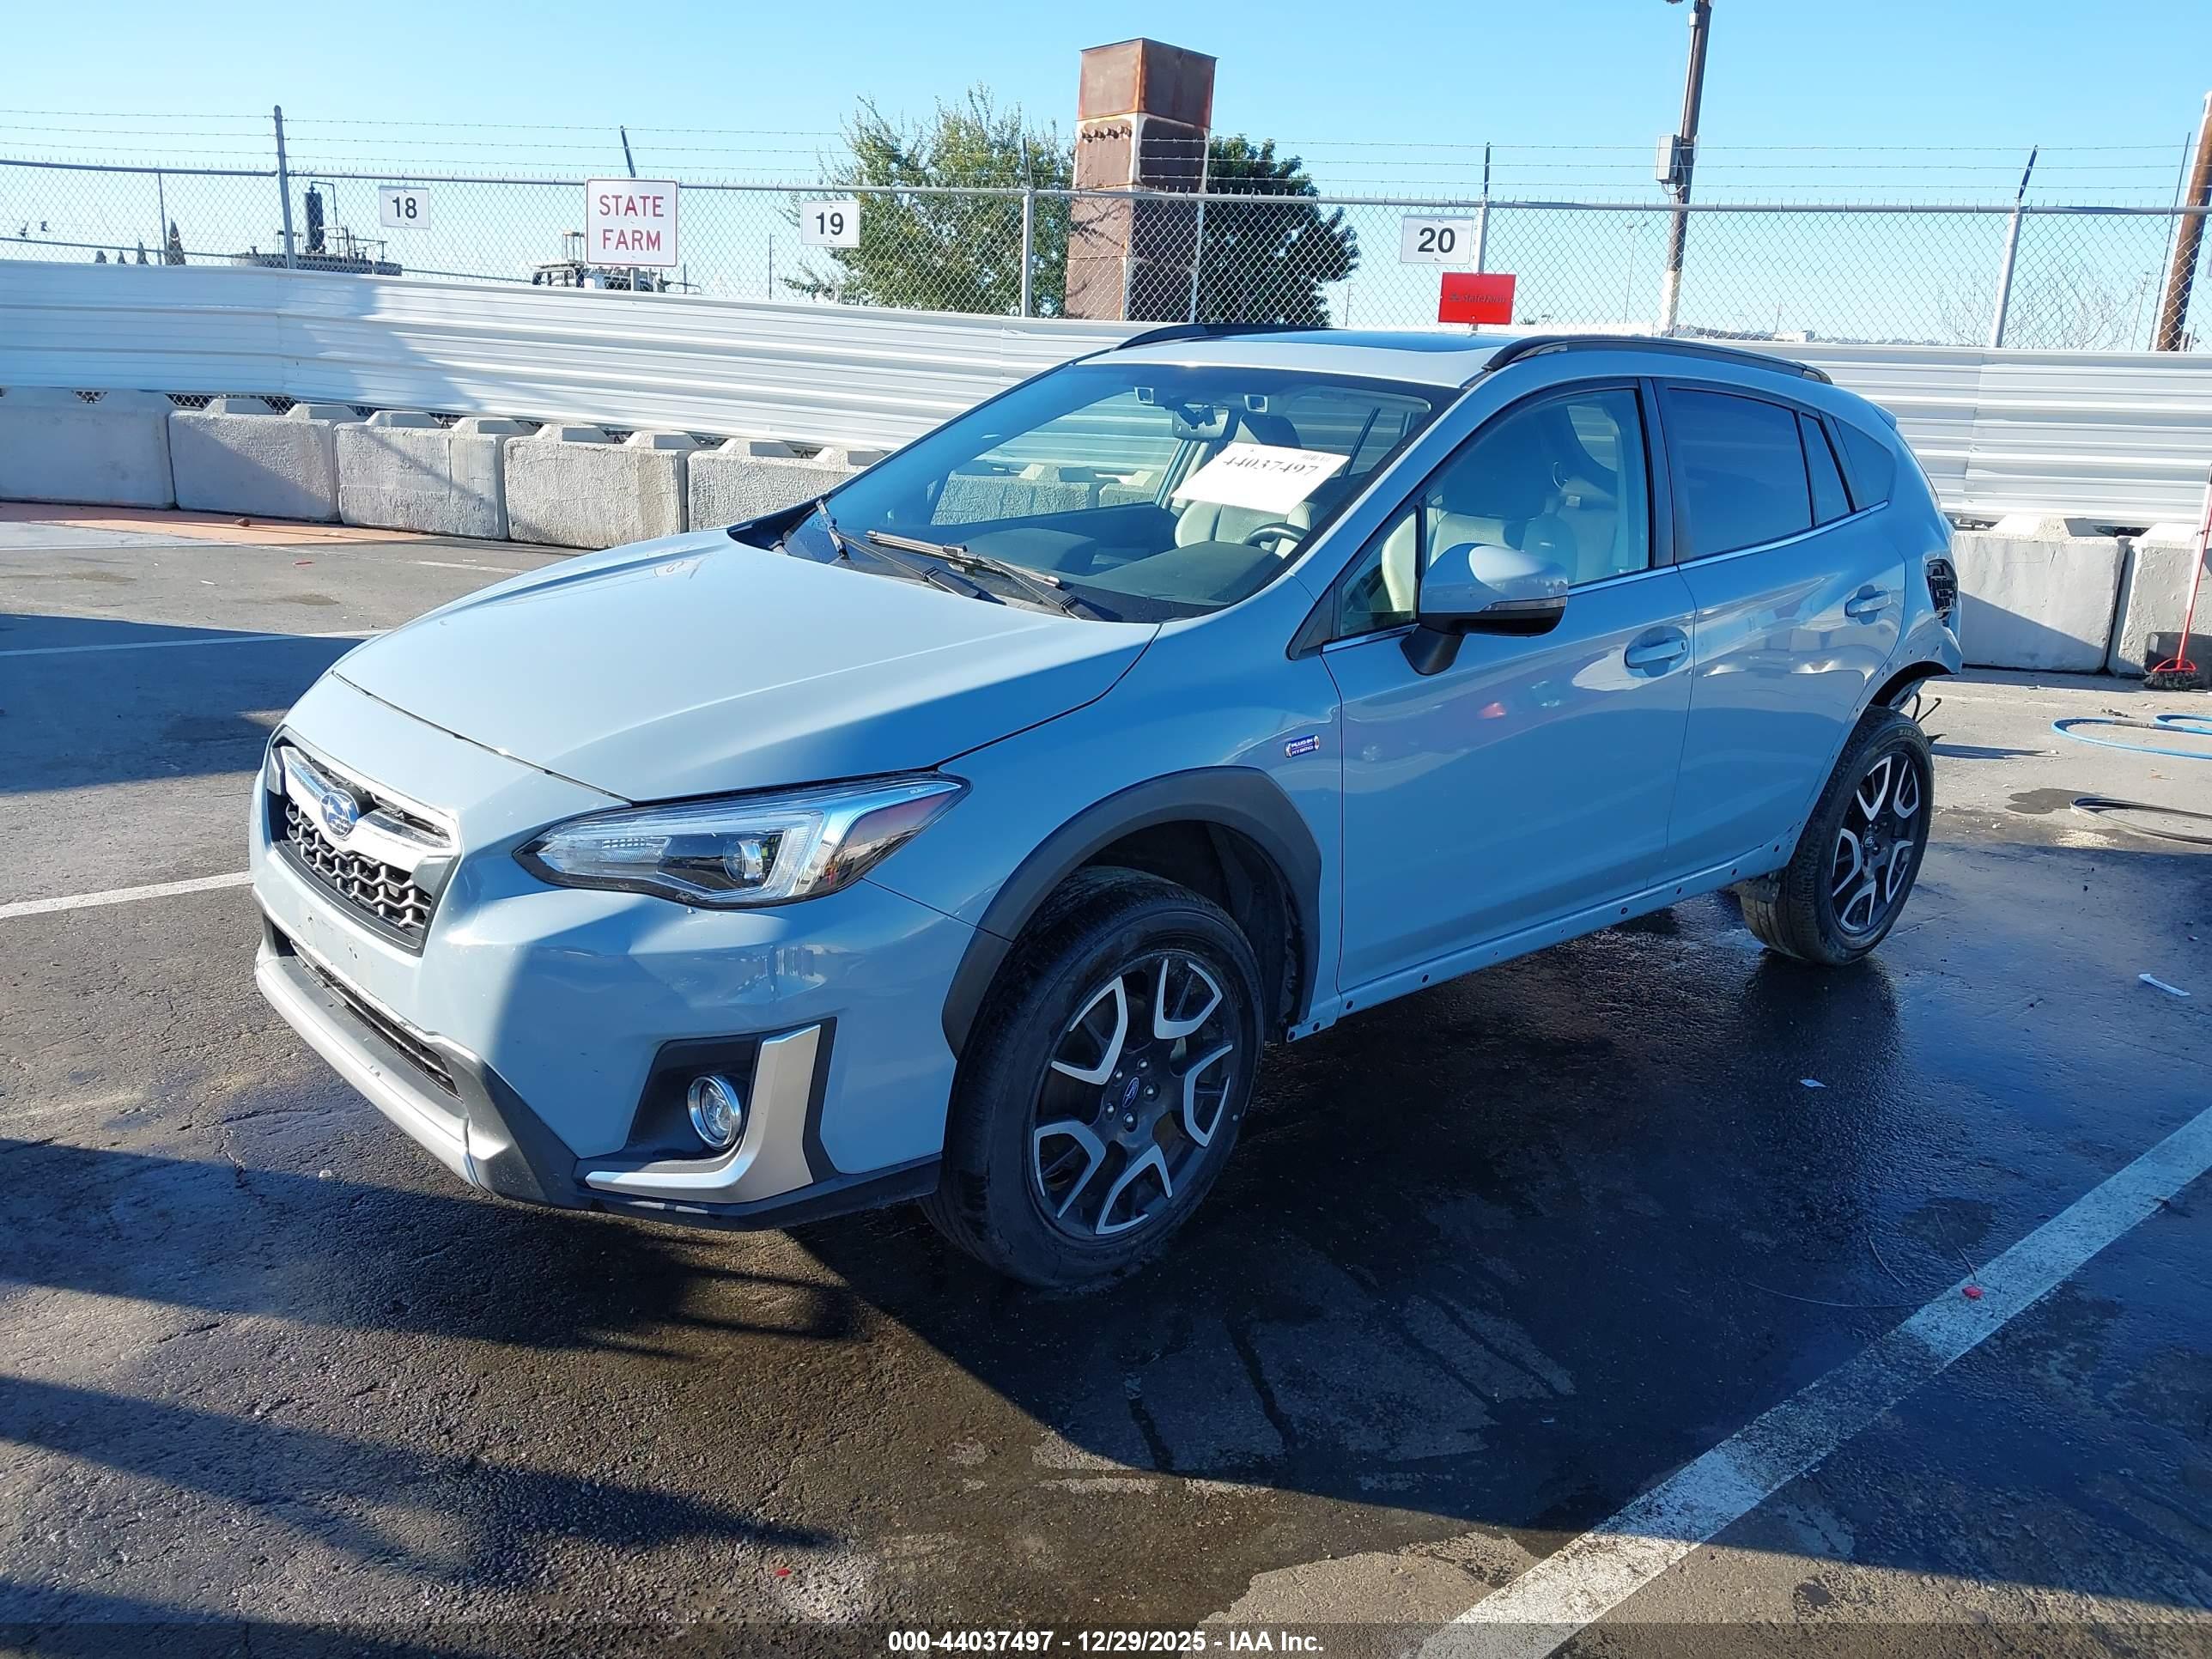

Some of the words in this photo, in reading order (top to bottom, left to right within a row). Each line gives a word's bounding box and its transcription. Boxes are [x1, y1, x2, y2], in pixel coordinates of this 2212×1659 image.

[392, 196, 417, 219] 18
[599, 194, 665, 217] STATE
[815, 211, 844, 236] 19
[602, 228, 661, 252] FARM
[1417, 227, 1455, 253] 20
[1223, 457, 1320, 476] 44037497
